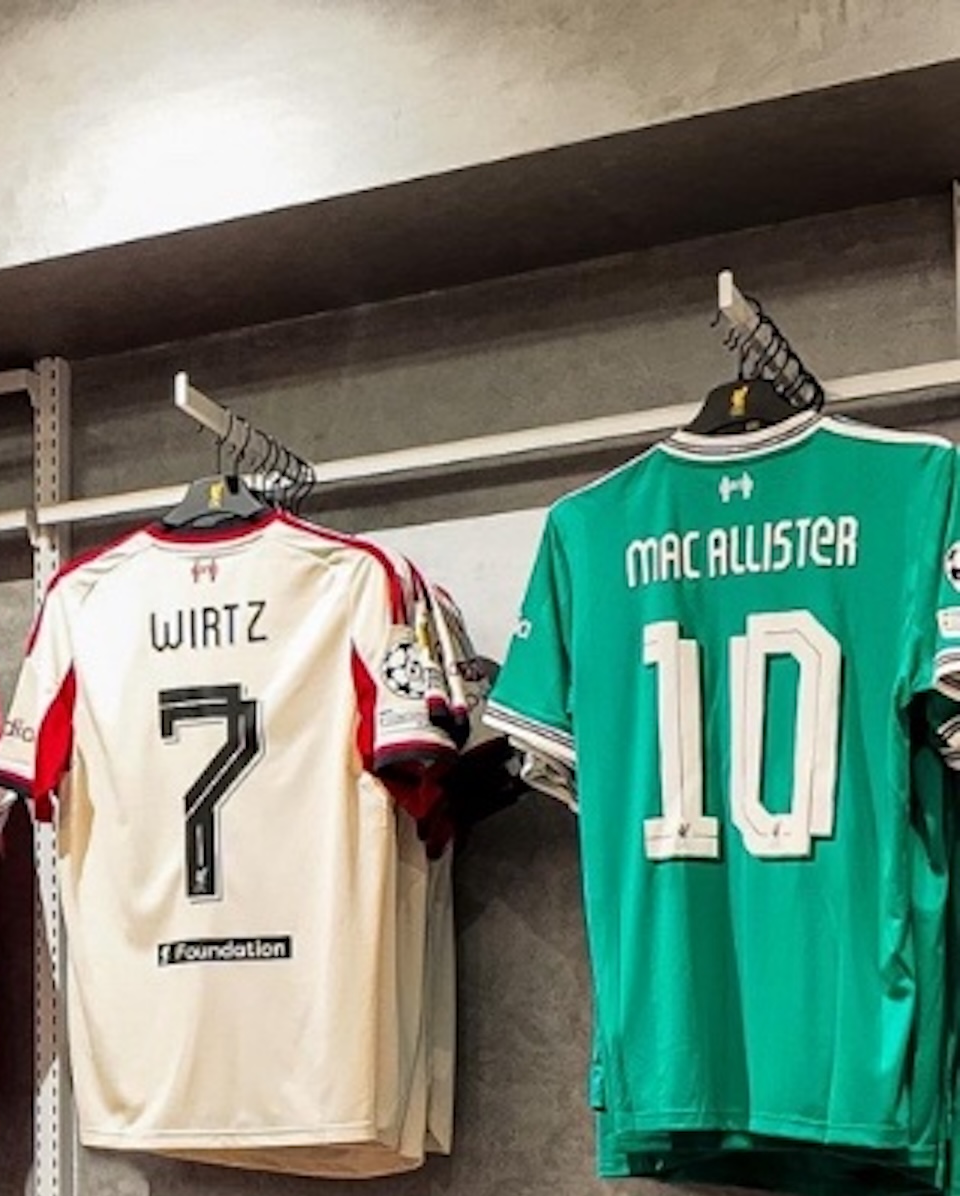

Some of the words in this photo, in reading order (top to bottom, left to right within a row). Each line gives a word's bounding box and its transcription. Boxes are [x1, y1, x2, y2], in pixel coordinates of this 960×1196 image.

[150, 600, 269, 653] WIRTZ
[625, 530, 701, 588] MAC
[158, 682, 266, 904] 7
[643, 608, 842, 860] 10
